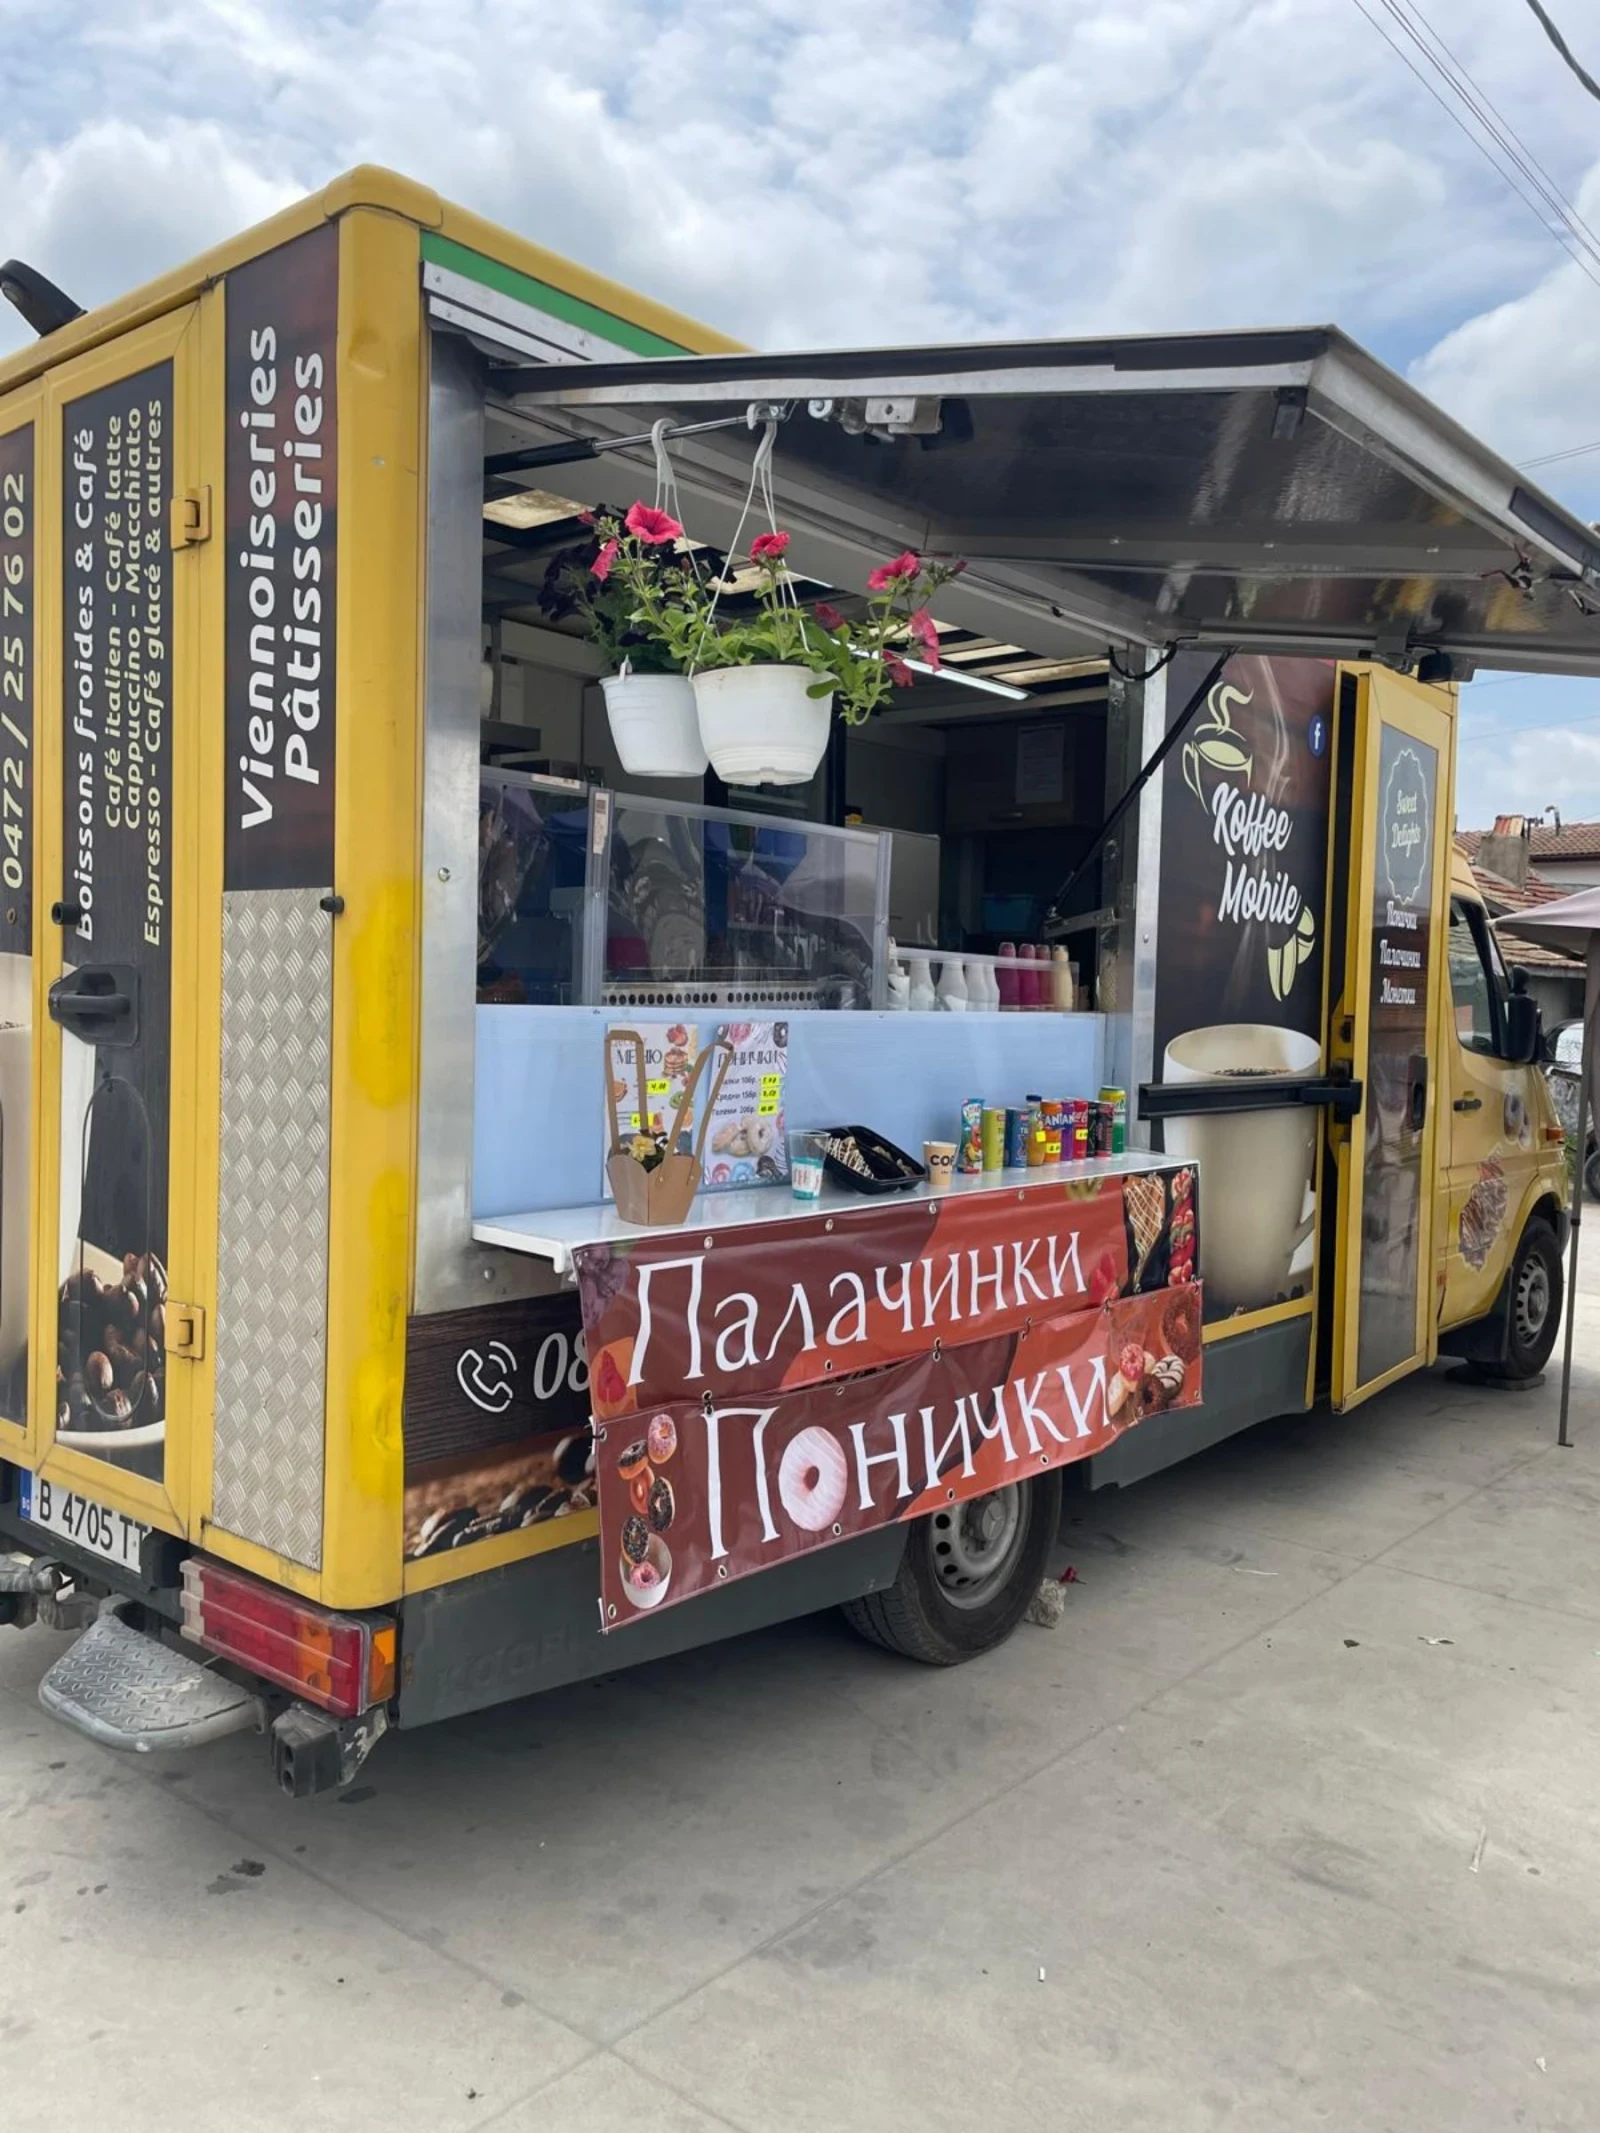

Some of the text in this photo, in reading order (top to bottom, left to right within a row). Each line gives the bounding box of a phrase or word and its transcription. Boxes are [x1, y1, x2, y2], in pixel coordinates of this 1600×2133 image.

[73, 429, 97, 528] Café
[105, 416, 122, 500] latte
[124, 408, 142, 593] Macchiato
[145, 400, 162, 517] autres
[74, 543, 93, 572] &
[104, 512, 122, 592] Café
[145, 528, 161, 552] &
[239, 325, 276, 829] Viennoiseries
[281, 352, 324, 785] Pâtisseries
[144, 564, 164, 659] glacé
[1, 473, 28, 889] 0472 / 25 76 02
[73, 586, 97, 741] froides
[104, 627, 122, 738] italien
[144, 670, 164, 752] Café
[124, 626, 144, 829] Cappuccino
[104, 748, 122, 828] Café
[1212, 781, 1293, 857] Koffee
[144, 787, 164, 945] Espresso
[1217, 859, 1302, 925] Mobile
[627, 1230, 1087, 1385] Палачинки
[62, 1493, 113, 1551] 4705
